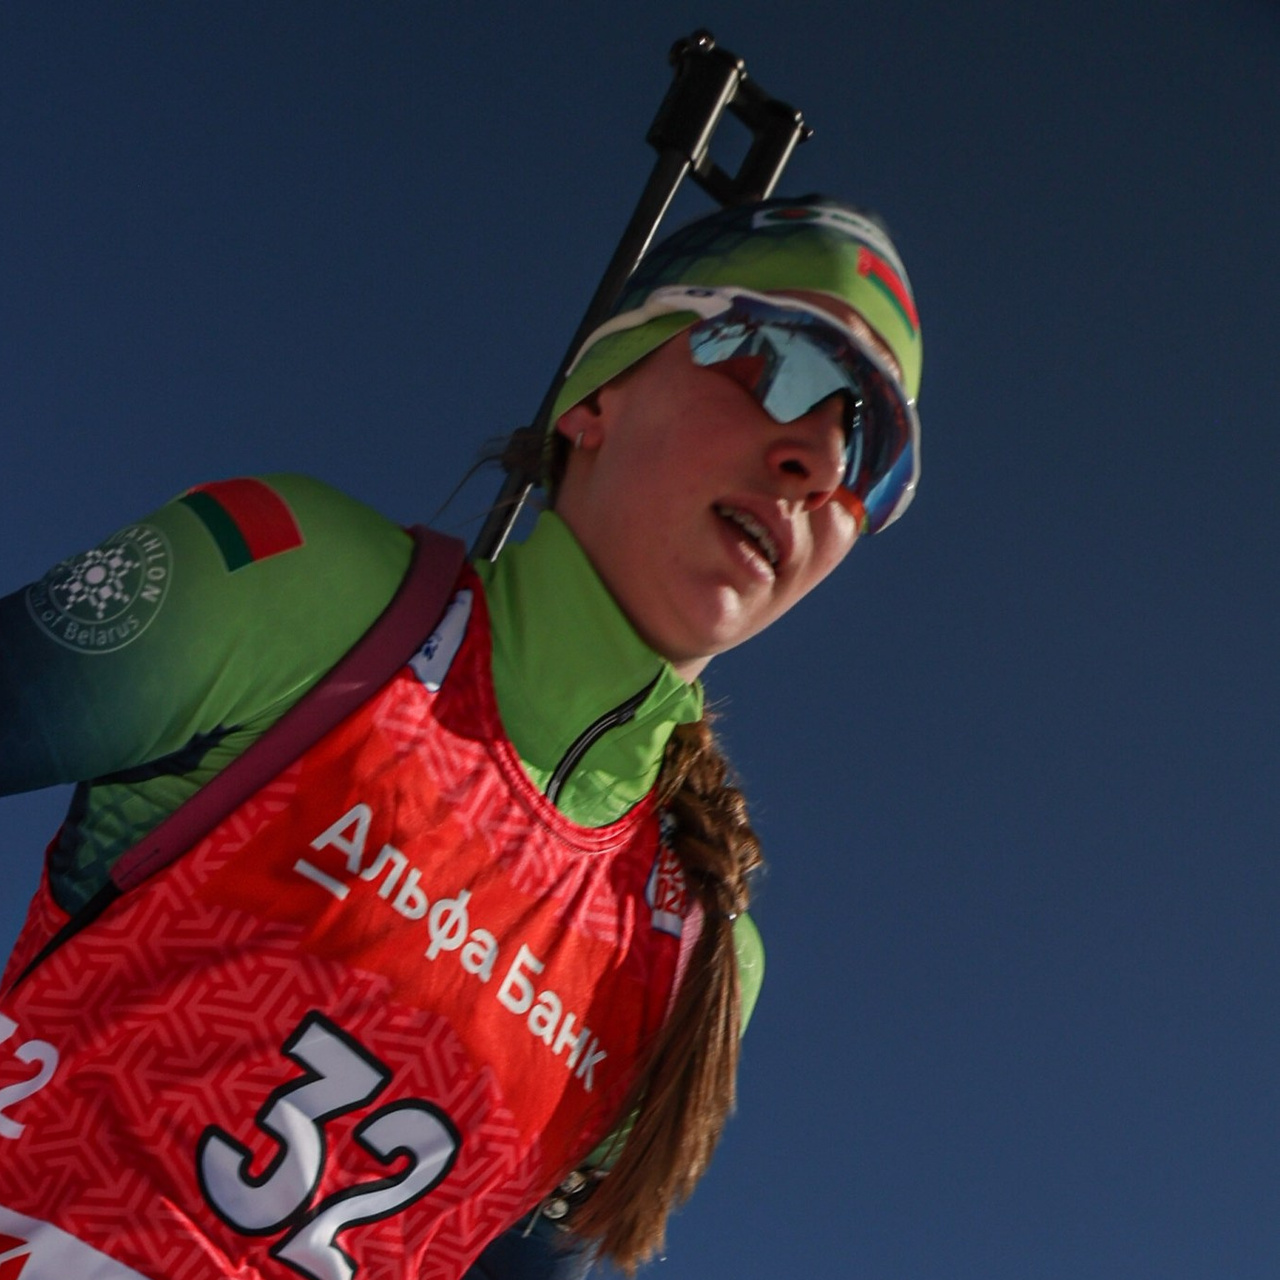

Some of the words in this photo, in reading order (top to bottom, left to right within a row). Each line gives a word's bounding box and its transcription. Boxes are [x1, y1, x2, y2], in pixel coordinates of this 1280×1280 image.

[63, 614, 141, 646] Belarus
[308, 803, 500, 984] Альфа
[496, 942, 608, 1093] Банк
